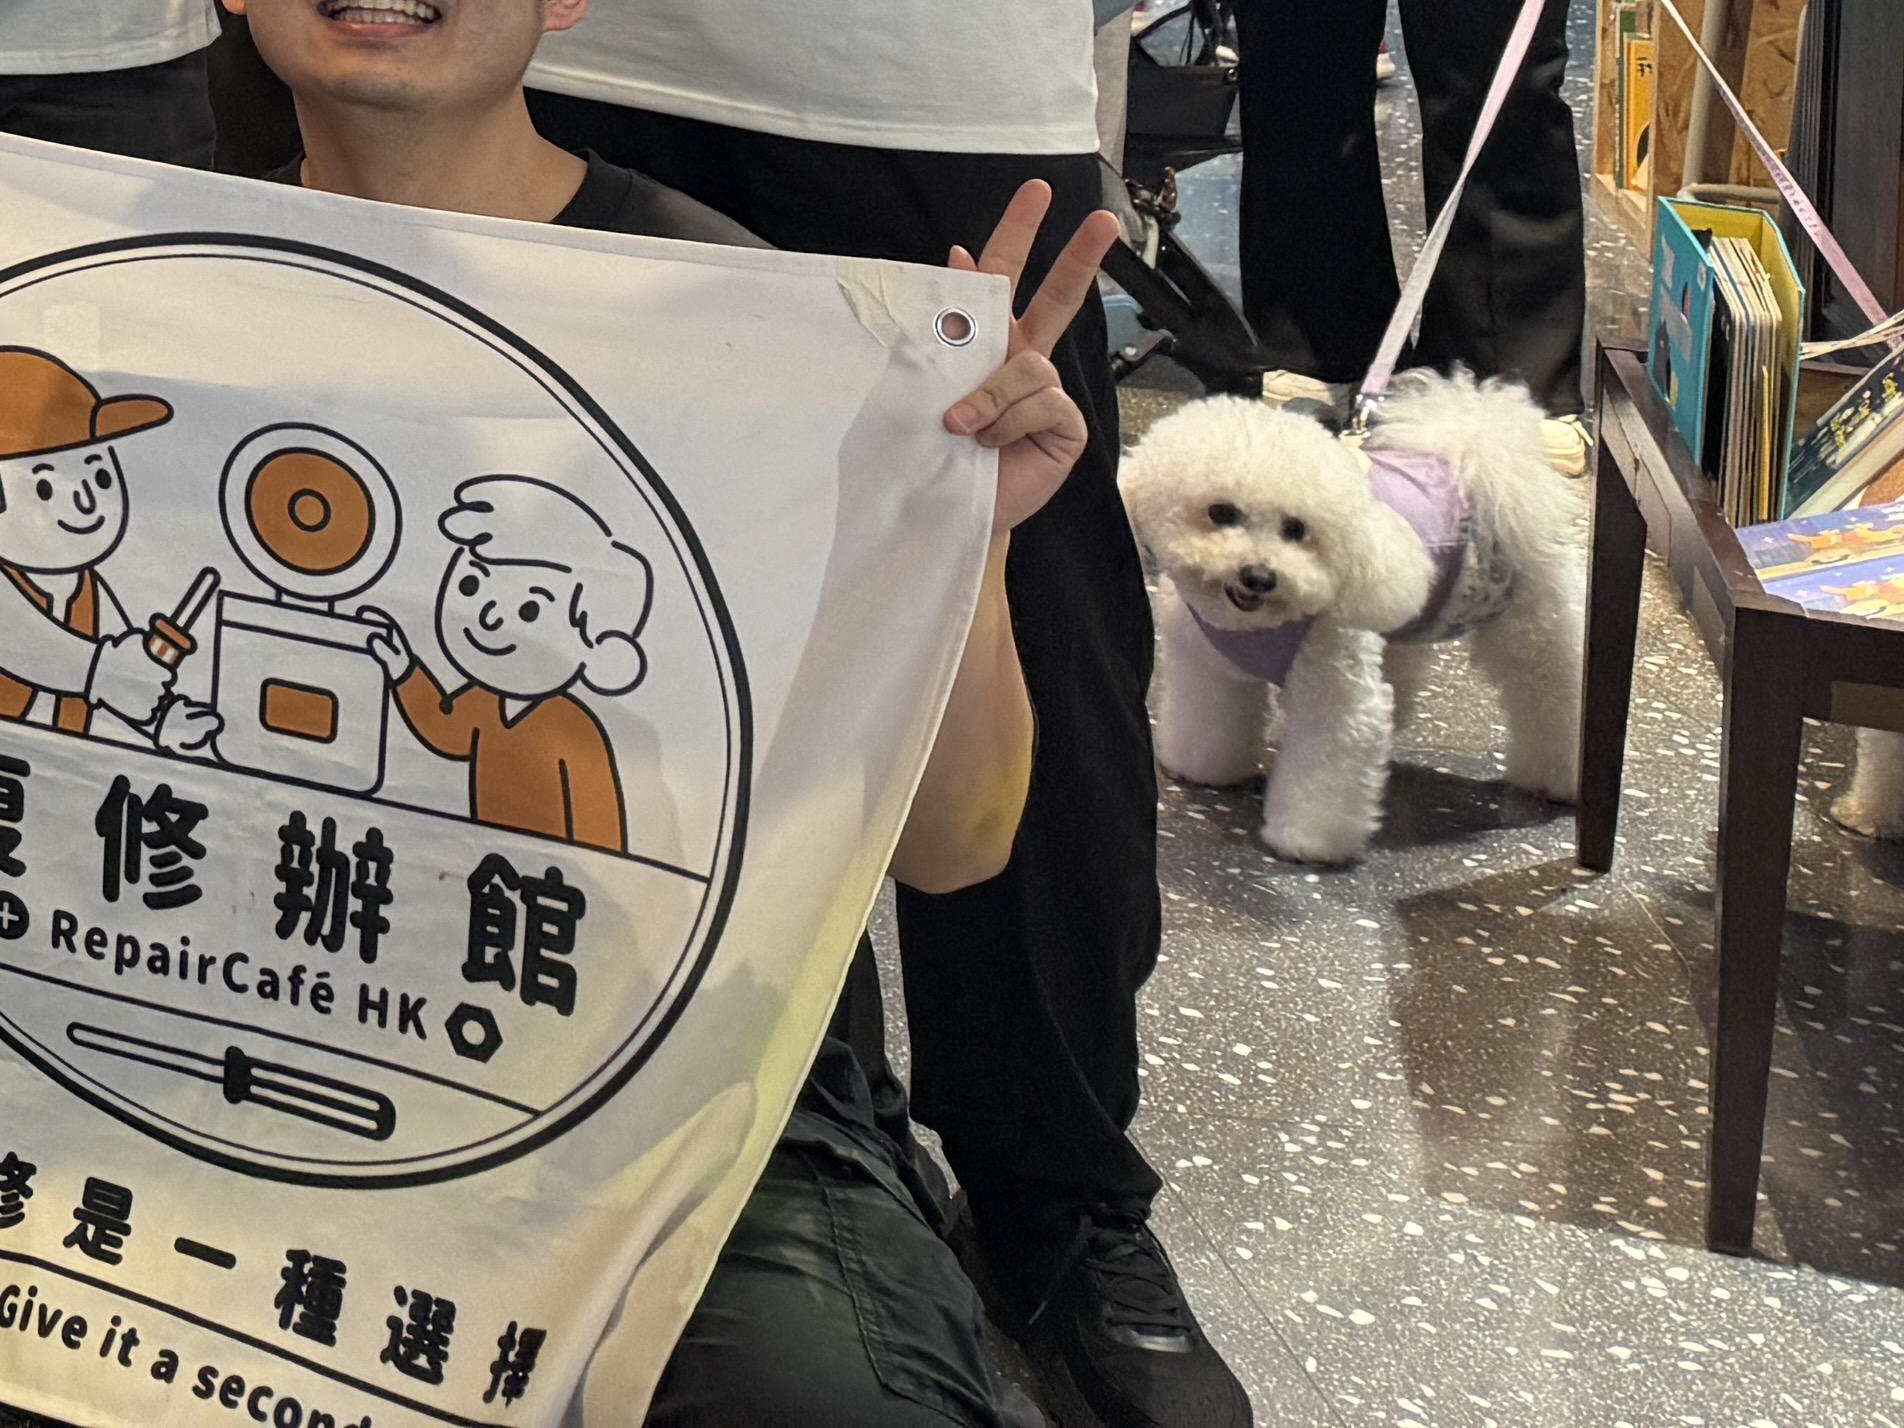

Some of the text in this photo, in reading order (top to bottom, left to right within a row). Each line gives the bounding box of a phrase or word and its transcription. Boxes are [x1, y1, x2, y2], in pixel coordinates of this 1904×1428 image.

[50, 910, 428, 1040] RepairCafé HK
[98, 1315, 141, 1367] it
[150, 1347, 180, 1383] a
